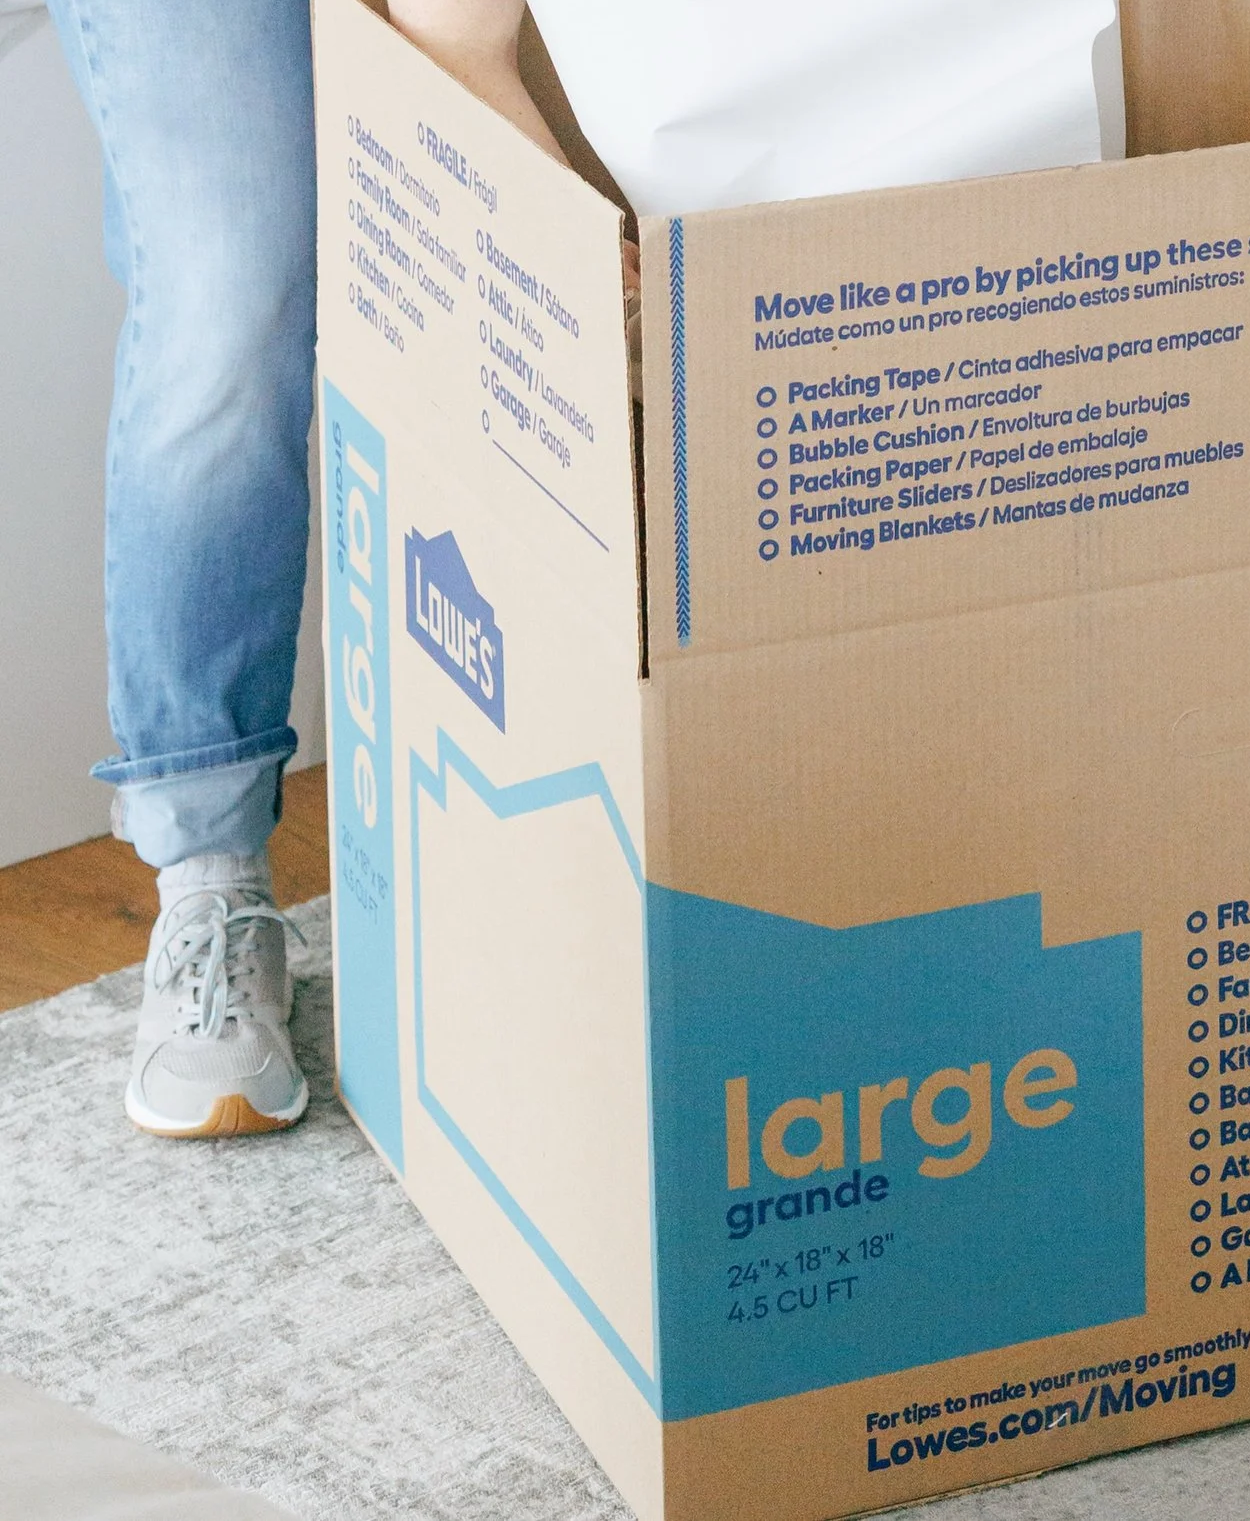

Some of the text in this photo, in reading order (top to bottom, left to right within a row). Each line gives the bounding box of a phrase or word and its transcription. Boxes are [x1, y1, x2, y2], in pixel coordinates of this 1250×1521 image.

[356, 118, 440, 217] Bedroom Dormitorio
[426, 126, 497, 214] FRAGILE Frágil
[356, 160, 466, 283] Family Room Sala familiar
[357, 201, 454, 313] Dining Room Comedor
[357, 244, 424, 331] Kitchen Cocina
[357, 285, 404, 353] Bath Baño
[486, 232, 579, 339] Basement Sótano
[488, 280, 544, 353] Attic Ático
[754, 293, 835, 323] Move
[840, 281, 891, 311] like
[895, 282, 916, 304] a
[921, 275, 970, 306] pro
[975, 265, 1012, 296] by
[1016, 251, 1120, 293] picking
[1124, 249, 1162, 275] up
[1166, 238, 1242, 266] these
[754, 271, 1245, 351] Múdate como un pro recogiendo estos suministros:
[490, 323, 594, 443] Laundry Lavandería
[788, 324, 1244, 405] Packing Tape Cinta adhesiva para empacar
[491, 370, 570, 469] Garage Garaje
[788, 383, 1043, 435] A Marker Un marcador
[789, 391, 1190, 465] Bubble Cushion Envoltura de burbujas
[333, 420, 346, 574] grande
[789, 425, 1148, 496] Packing Paper Papel de embalaje
[790, 440, 1244, 526] Furniture Sliders Deslizadores para muebles
[790, 479, 1190, 557] Moving Blankets Mantas de mudanza
[342, 441, 379, 829] large
[415, 554, 494, 700] LOWE'S
[725, 1048, 1078, 1190] large
[725, 1168, 890, 1239] grande
[727, 1233, 895, 1289] 24" x 18" x 18"
[727, 1277, 858, 1323] 4.5 CU FT
[1220, 1262, 1243, 1289] A
[866, 1411, 901, 1433] For
[902, 1402, 942, 1426] tips
[943, 1397, 967, 1415] to
[969, 1382, 1026, 1409] make
[1028, 1371, 1076, 1399] your
[1077, 1359, 1132, 1384] move
[1134, 1352, 1161, 1375] go
[866, 1362, 1236, 1472] Lowes.com/Moving
